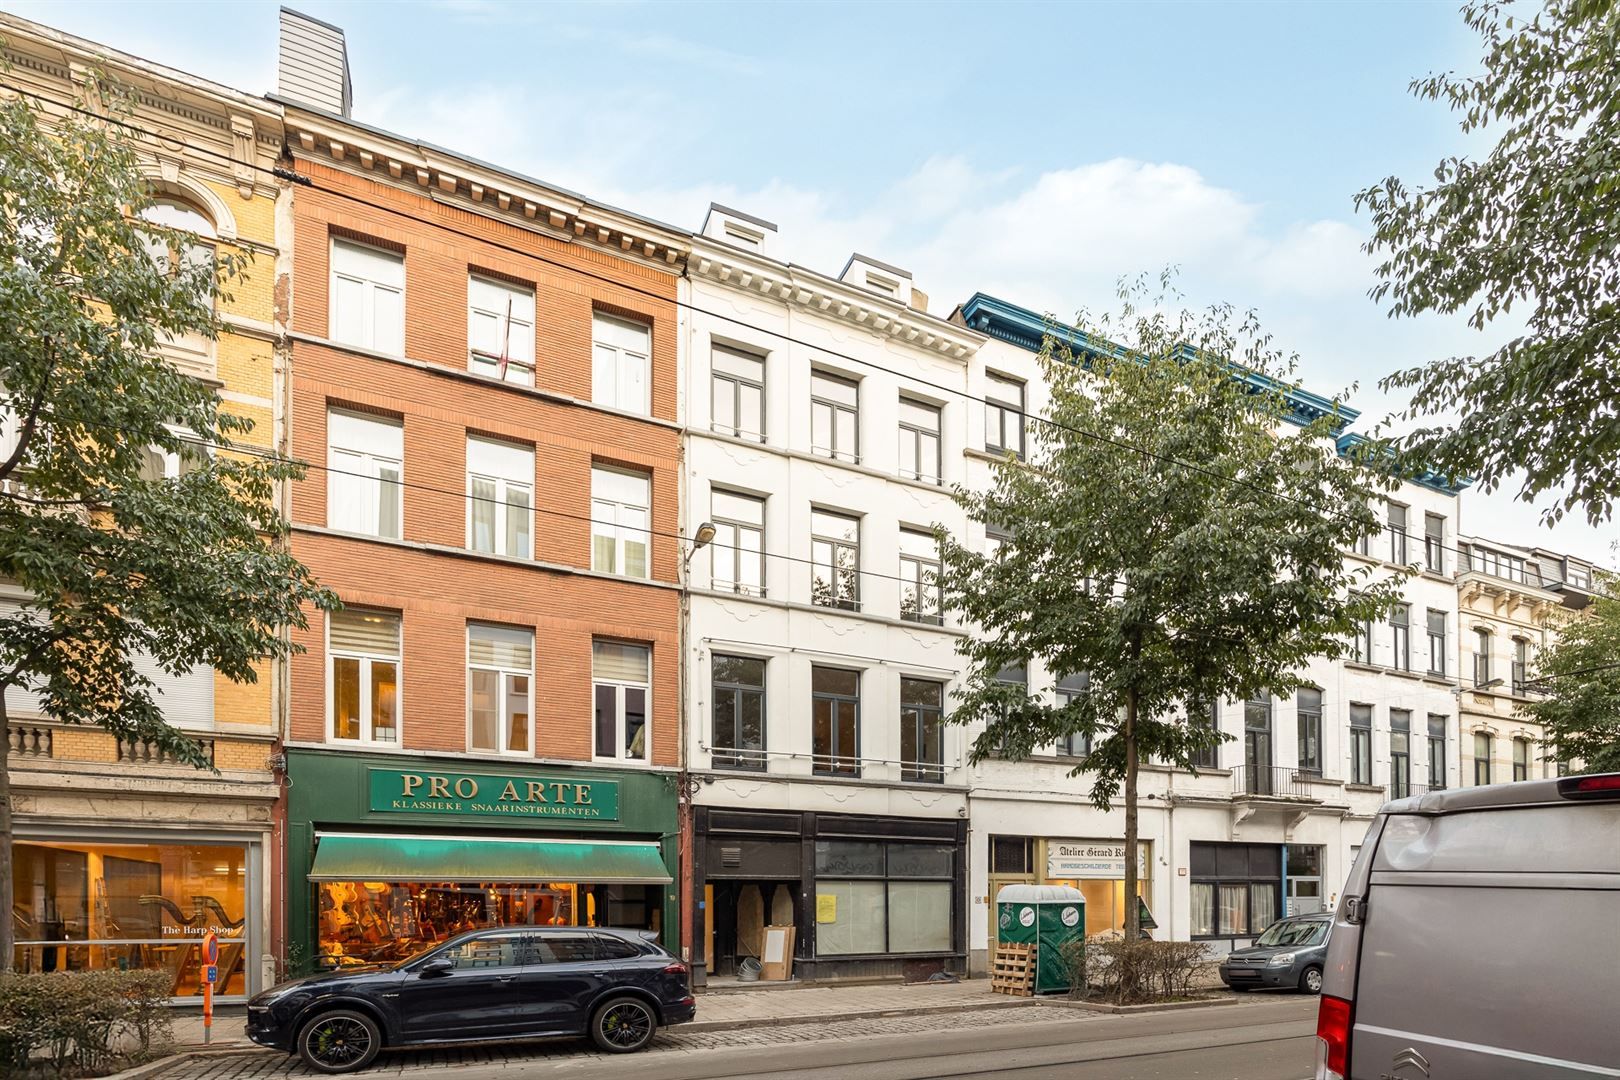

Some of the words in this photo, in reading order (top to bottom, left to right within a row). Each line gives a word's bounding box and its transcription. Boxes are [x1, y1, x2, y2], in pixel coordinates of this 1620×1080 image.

[401, 774, 479, 799] PRO
[499, 780, 592, 804] ARTE
[392, 800, 462, 811] KLASSIEKE
[471, 803, 600, 816] SNAARINSTRUMENTEN
[1060, 846, 1085, 857] Atelier
[162, 926, 180, 934] The
[183, 926, 207, 935] Harp
[210, 925, 233, 935] Shop
